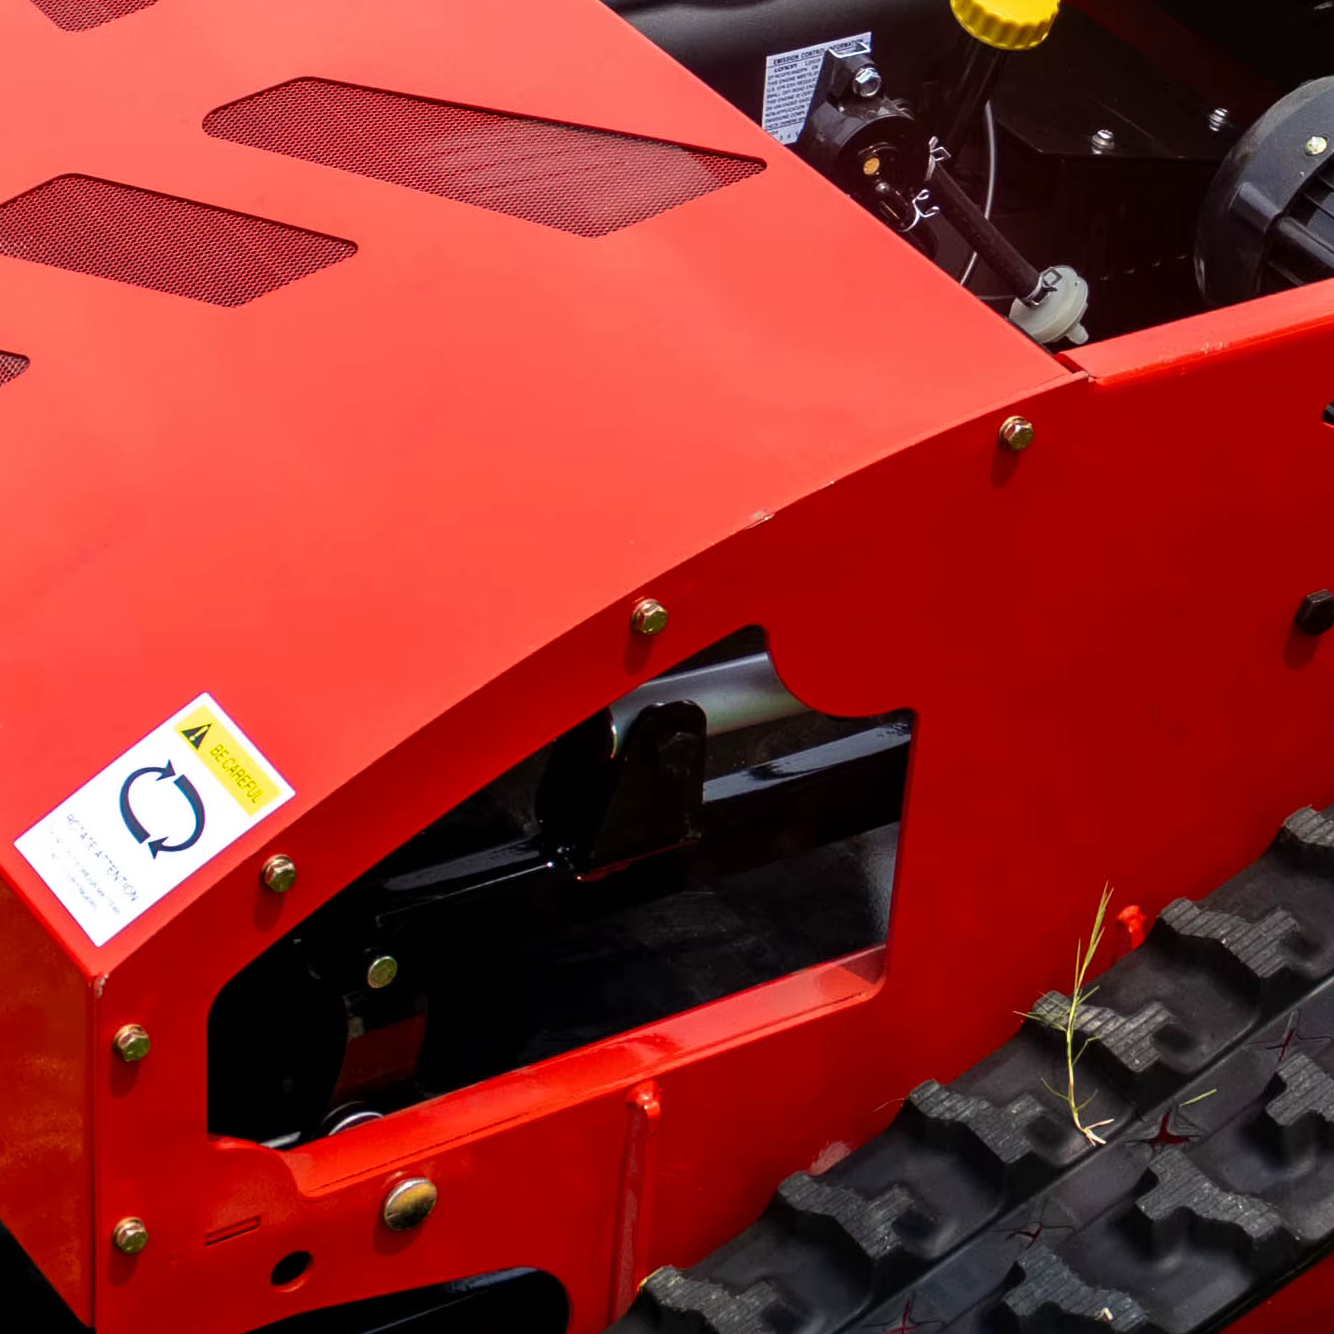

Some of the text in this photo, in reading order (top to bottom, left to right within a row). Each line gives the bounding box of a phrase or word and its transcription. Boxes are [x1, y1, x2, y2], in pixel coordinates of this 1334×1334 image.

[773, 55, 799, 65] EMISSION
[210, 744, 264, 804] BE CAREFUL
